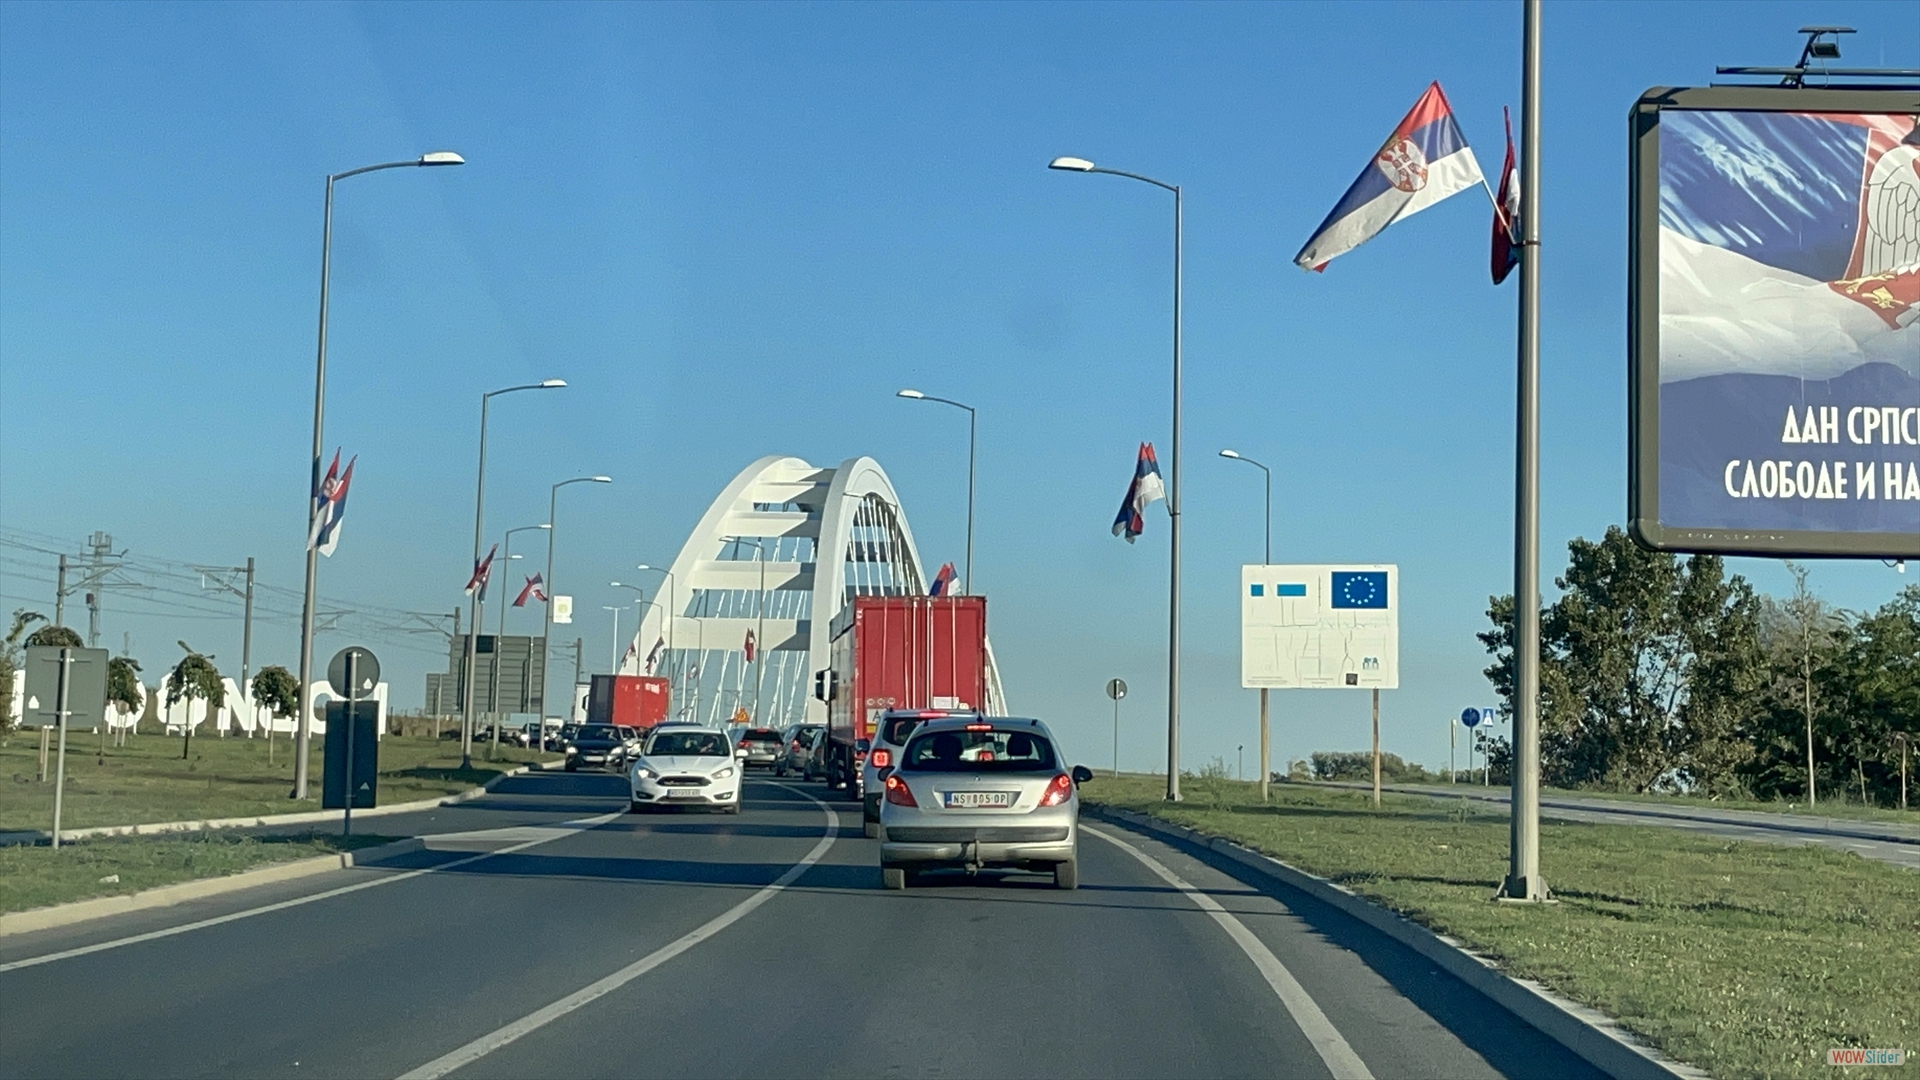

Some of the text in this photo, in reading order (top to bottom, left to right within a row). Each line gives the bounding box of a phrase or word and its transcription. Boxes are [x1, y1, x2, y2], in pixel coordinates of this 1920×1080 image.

[1782, 405, 1920, 446] ДАН СРПС
[1724, 460, 1849, 500] СЛОБОДЕ
[1856, 461, 1876, 501] И
